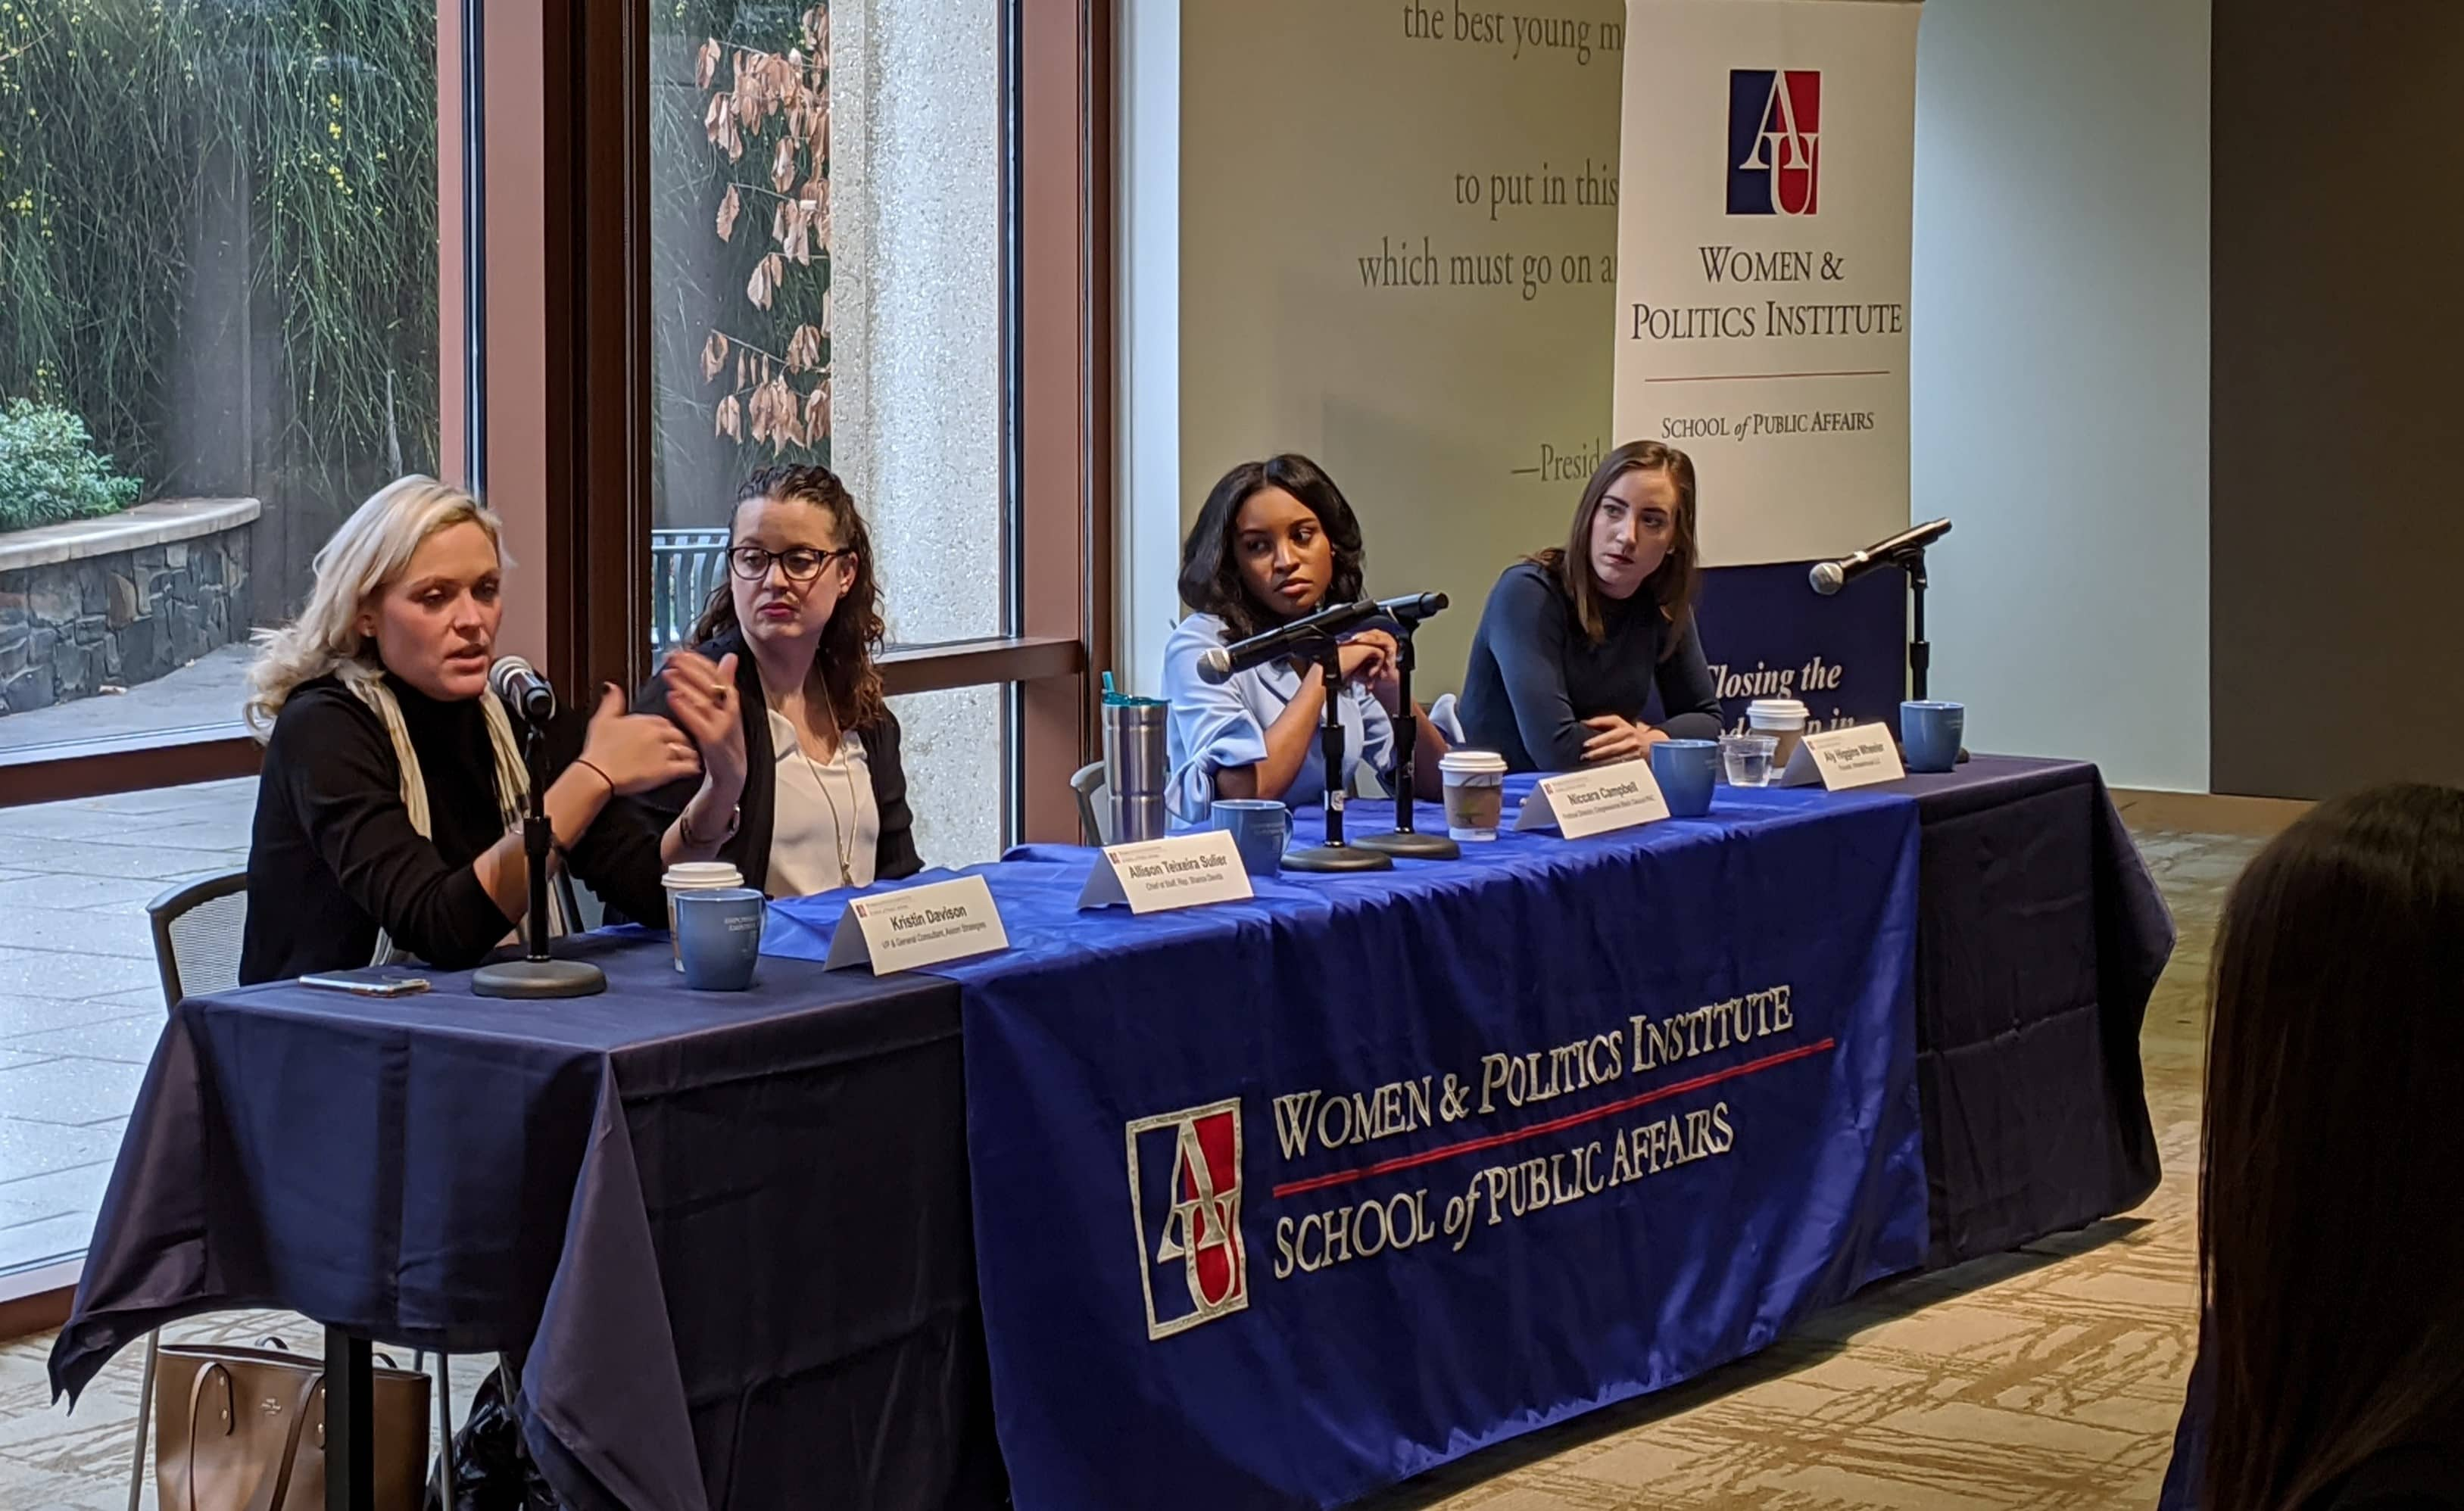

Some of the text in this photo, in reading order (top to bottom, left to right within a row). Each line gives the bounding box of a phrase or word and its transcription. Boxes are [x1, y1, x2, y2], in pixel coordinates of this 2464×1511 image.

[1404, 0, 1444, 39] the
[1454, 0, 1504, 43] best
[1513, 14, 1591, 66] young
[1455, 158, 1618, 221] to put in this
[1358, 235, 1439, 287] which
[1449, 253, 1513, 285] must
[1522, 254, 1552, 301] go
[1561, 254, 1592, 285] on
[1698, 246, 1845, 283] WOMEN &
[1630, 301, 1903, 340] POLITICS INSTITUTE
[1661, 411, 1875, 441] SCHOOL of PUBLIC AFFAIRS
[1801, 656, 1842, 691] the
[1599, 780, 1639, 799] Campbell
[1128, 864, 1164, 880] Allison
[890, 911, 926, 933] Kristin
[925, 905, 968, 925] Davison
[1272, 984, 1794, 1161] WOMEN & POLITICS INSTITUTE
[1274, 1101, 1734, 1279] SCHOOL of PUBLIC AFFAIRS
